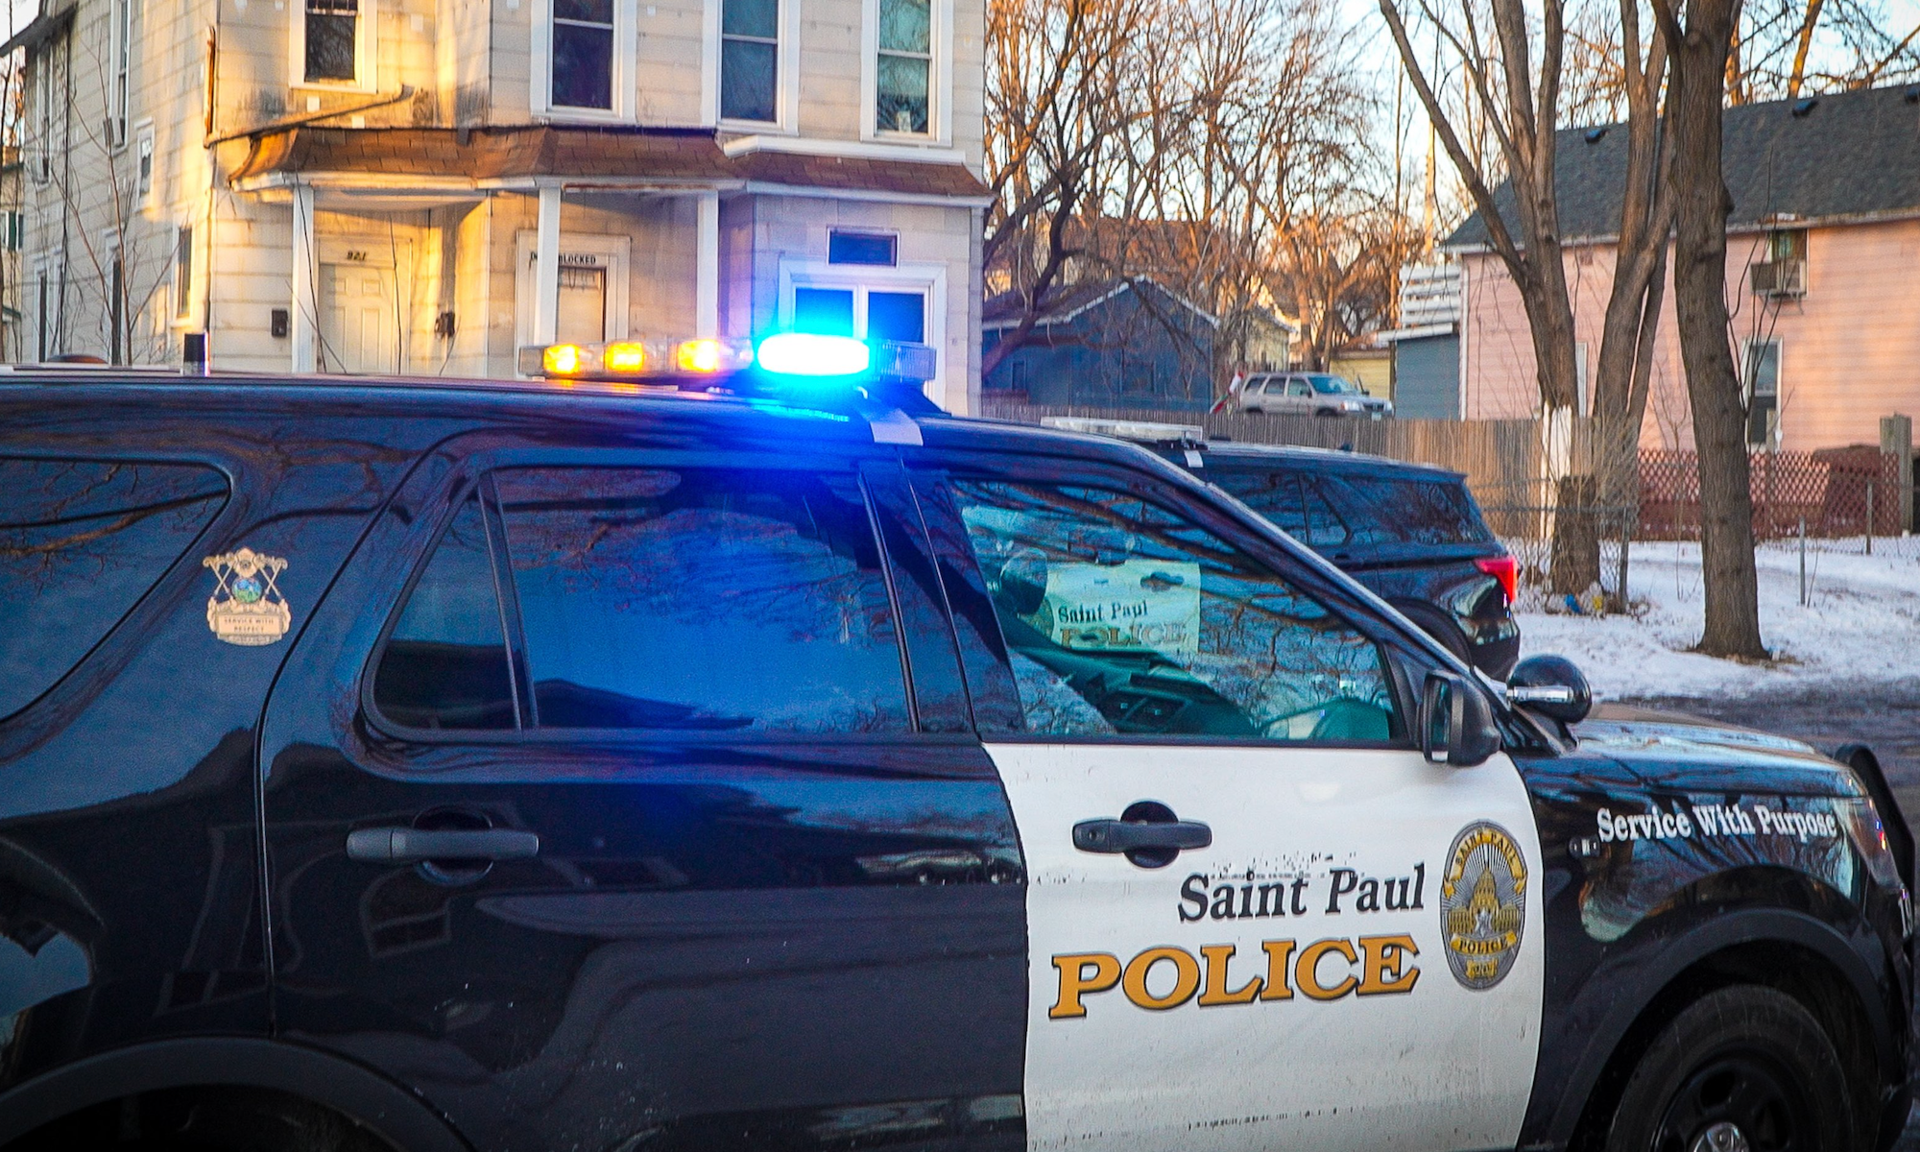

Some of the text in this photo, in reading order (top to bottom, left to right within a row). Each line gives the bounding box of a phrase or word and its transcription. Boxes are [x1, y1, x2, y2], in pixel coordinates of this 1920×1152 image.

[1058, 600, 1148, 623] Saint Paul
[1597, 803, 1837, 844] Service With Purpose
[1454, 829, 1517, 867] SAINT PAUL
[1177, 862, 1426, 923] Saint Paul
[1459, 935, 1508, 955] POLICE
[1048, 932, 1421, 1020] POLICE
